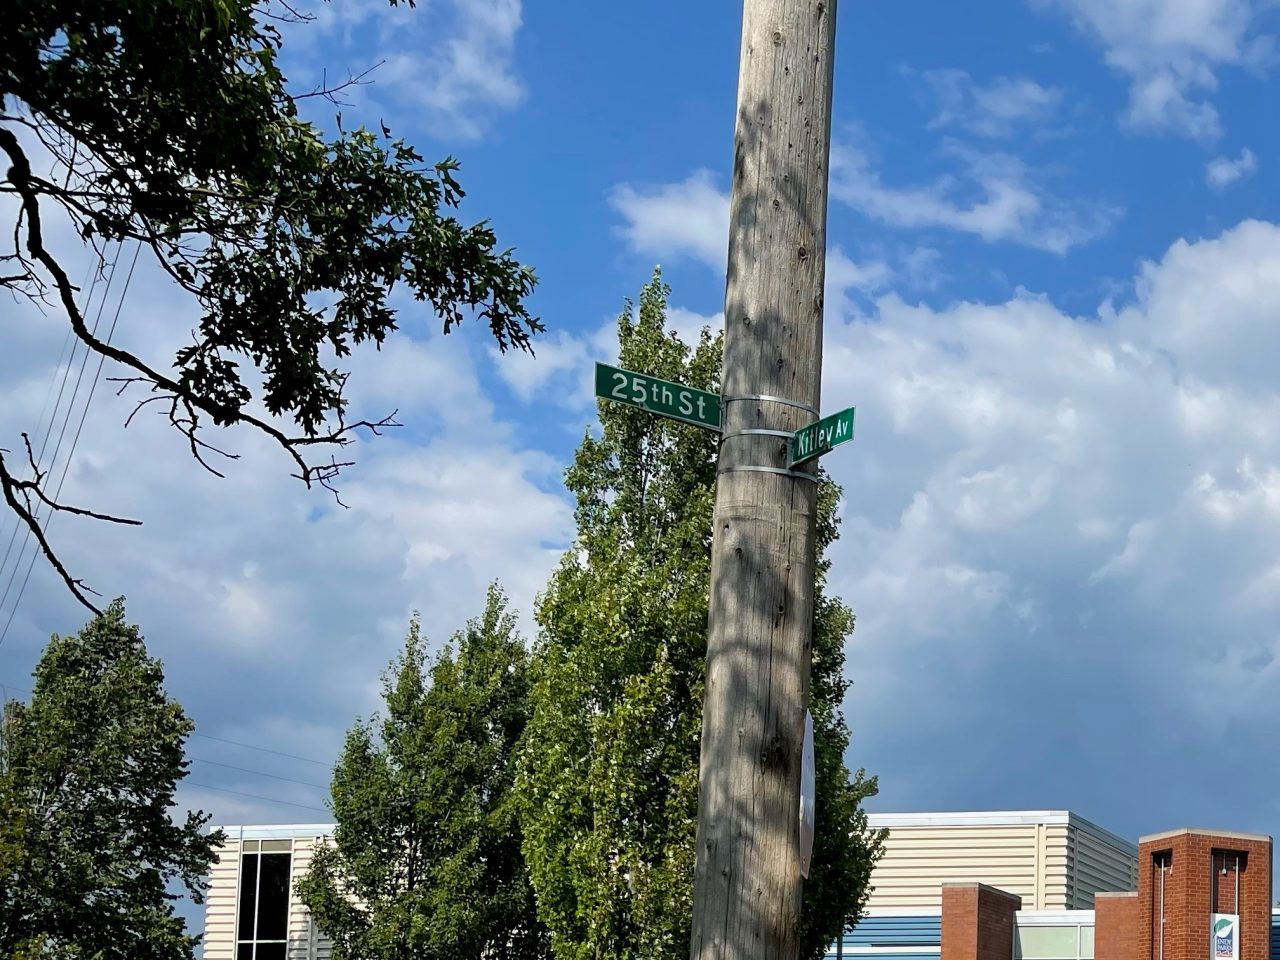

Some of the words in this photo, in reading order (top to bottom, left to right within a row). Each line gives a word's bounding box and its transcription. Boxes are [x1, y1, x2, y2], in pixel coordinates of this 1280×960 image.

[611, 372, 673, 406] 25th
[678, 391, 706, 419] St
[797, 425, 833, 456] Kitley
[836, 419, 849, 439] Av
